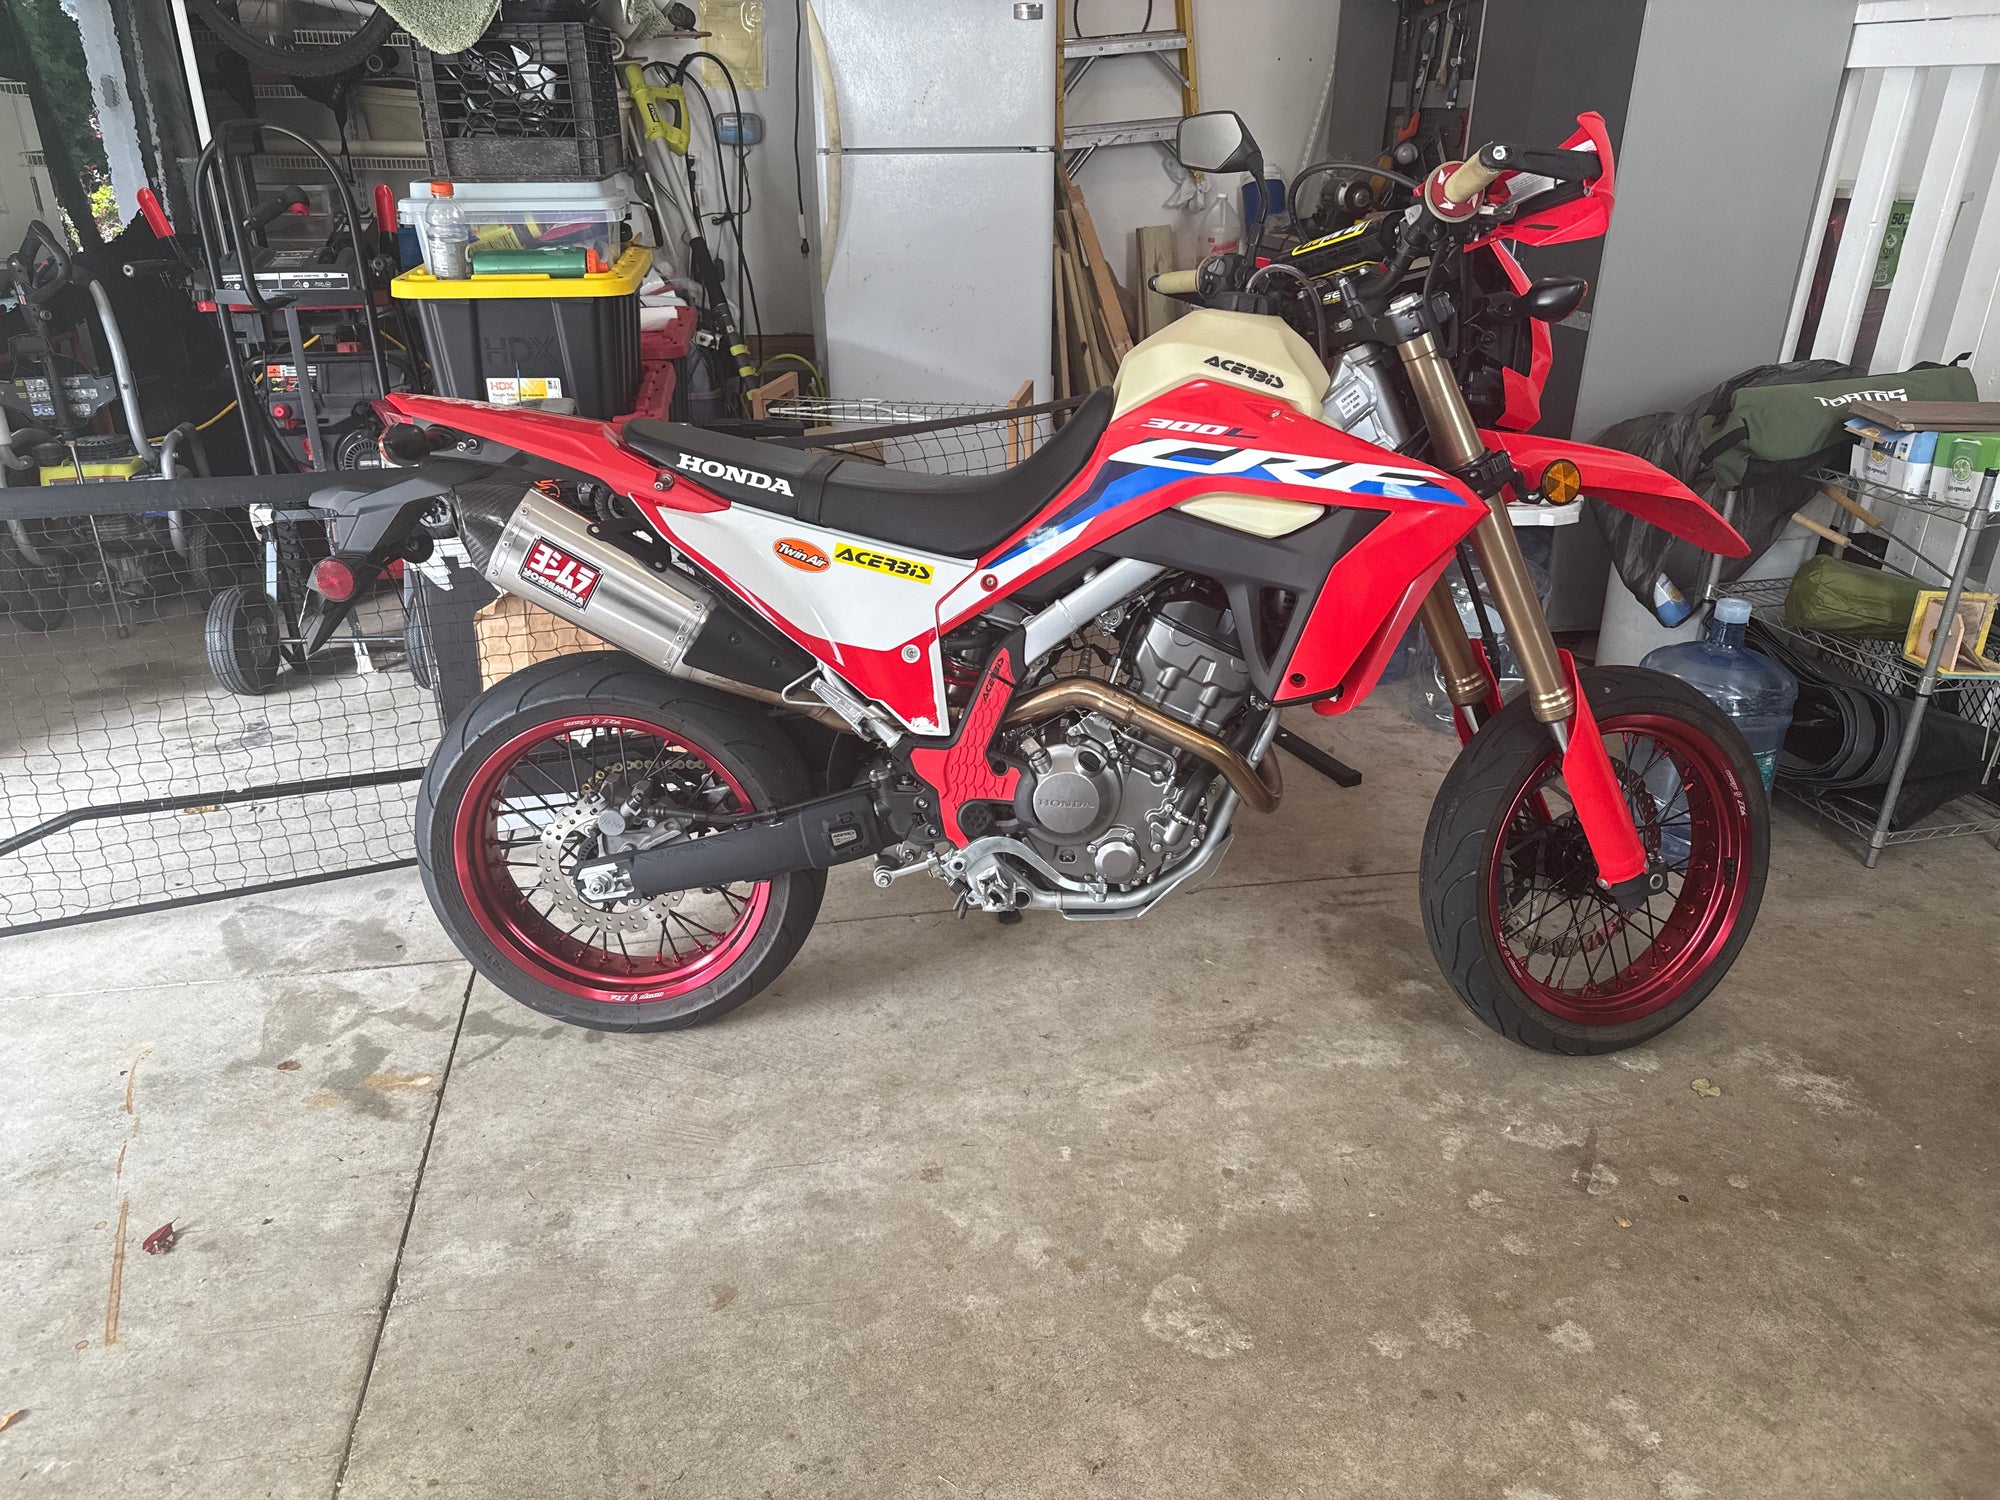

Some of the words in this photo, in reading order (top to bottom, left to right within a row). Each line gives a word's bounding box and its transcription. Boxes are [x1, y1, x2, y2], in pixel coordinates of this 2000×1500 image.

[482, 336, 559, 364] HDX
[490, 381, 516, 392] HDX
[1204, 355, 1285, 389] ACERBIS
[1141, 418, 1258, 439] 300L
[676, 452, 795, 497] HONDA
[1107, 438, 1450, 493] CRF
[529, 543, 596, 594] ヨシムラ
[778, 542, 808, 561] Twin
[806, 555, 828, 568] Air
[835, 547, 930, 580] ACERBIS
[522, 567, 584, 606] YOSHIMURA
[1038, 798, 1096, 809] HONDA
